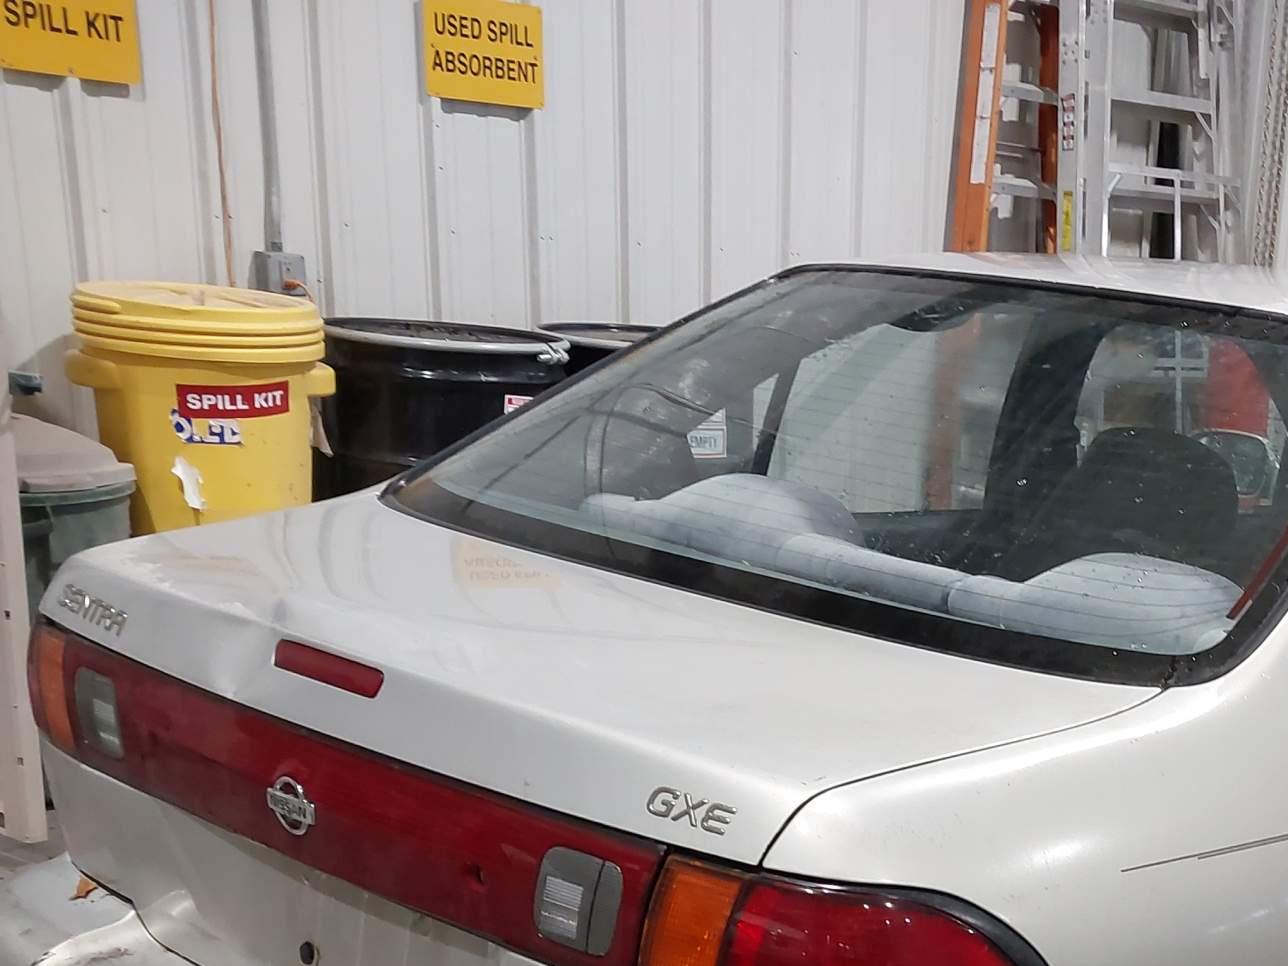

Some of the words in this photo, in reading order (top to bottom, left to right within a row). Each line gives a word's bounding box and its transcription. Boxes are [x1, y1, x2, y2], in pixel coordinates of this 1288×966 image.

[3, 0, 79, 36] SPILL
[84, 10, 124, 42] KIT
[433, 12, 482, 40] USED
[487, 20, 534, 48] SPILL
[432, 49, 538, 84] ABSORBENT
[186, 393, 249, 410] SPILL
[253, 391, 284, 408] KIT
[58, 583, 128, 637] SENTRA
[646, 786, 737, 836] GXE
